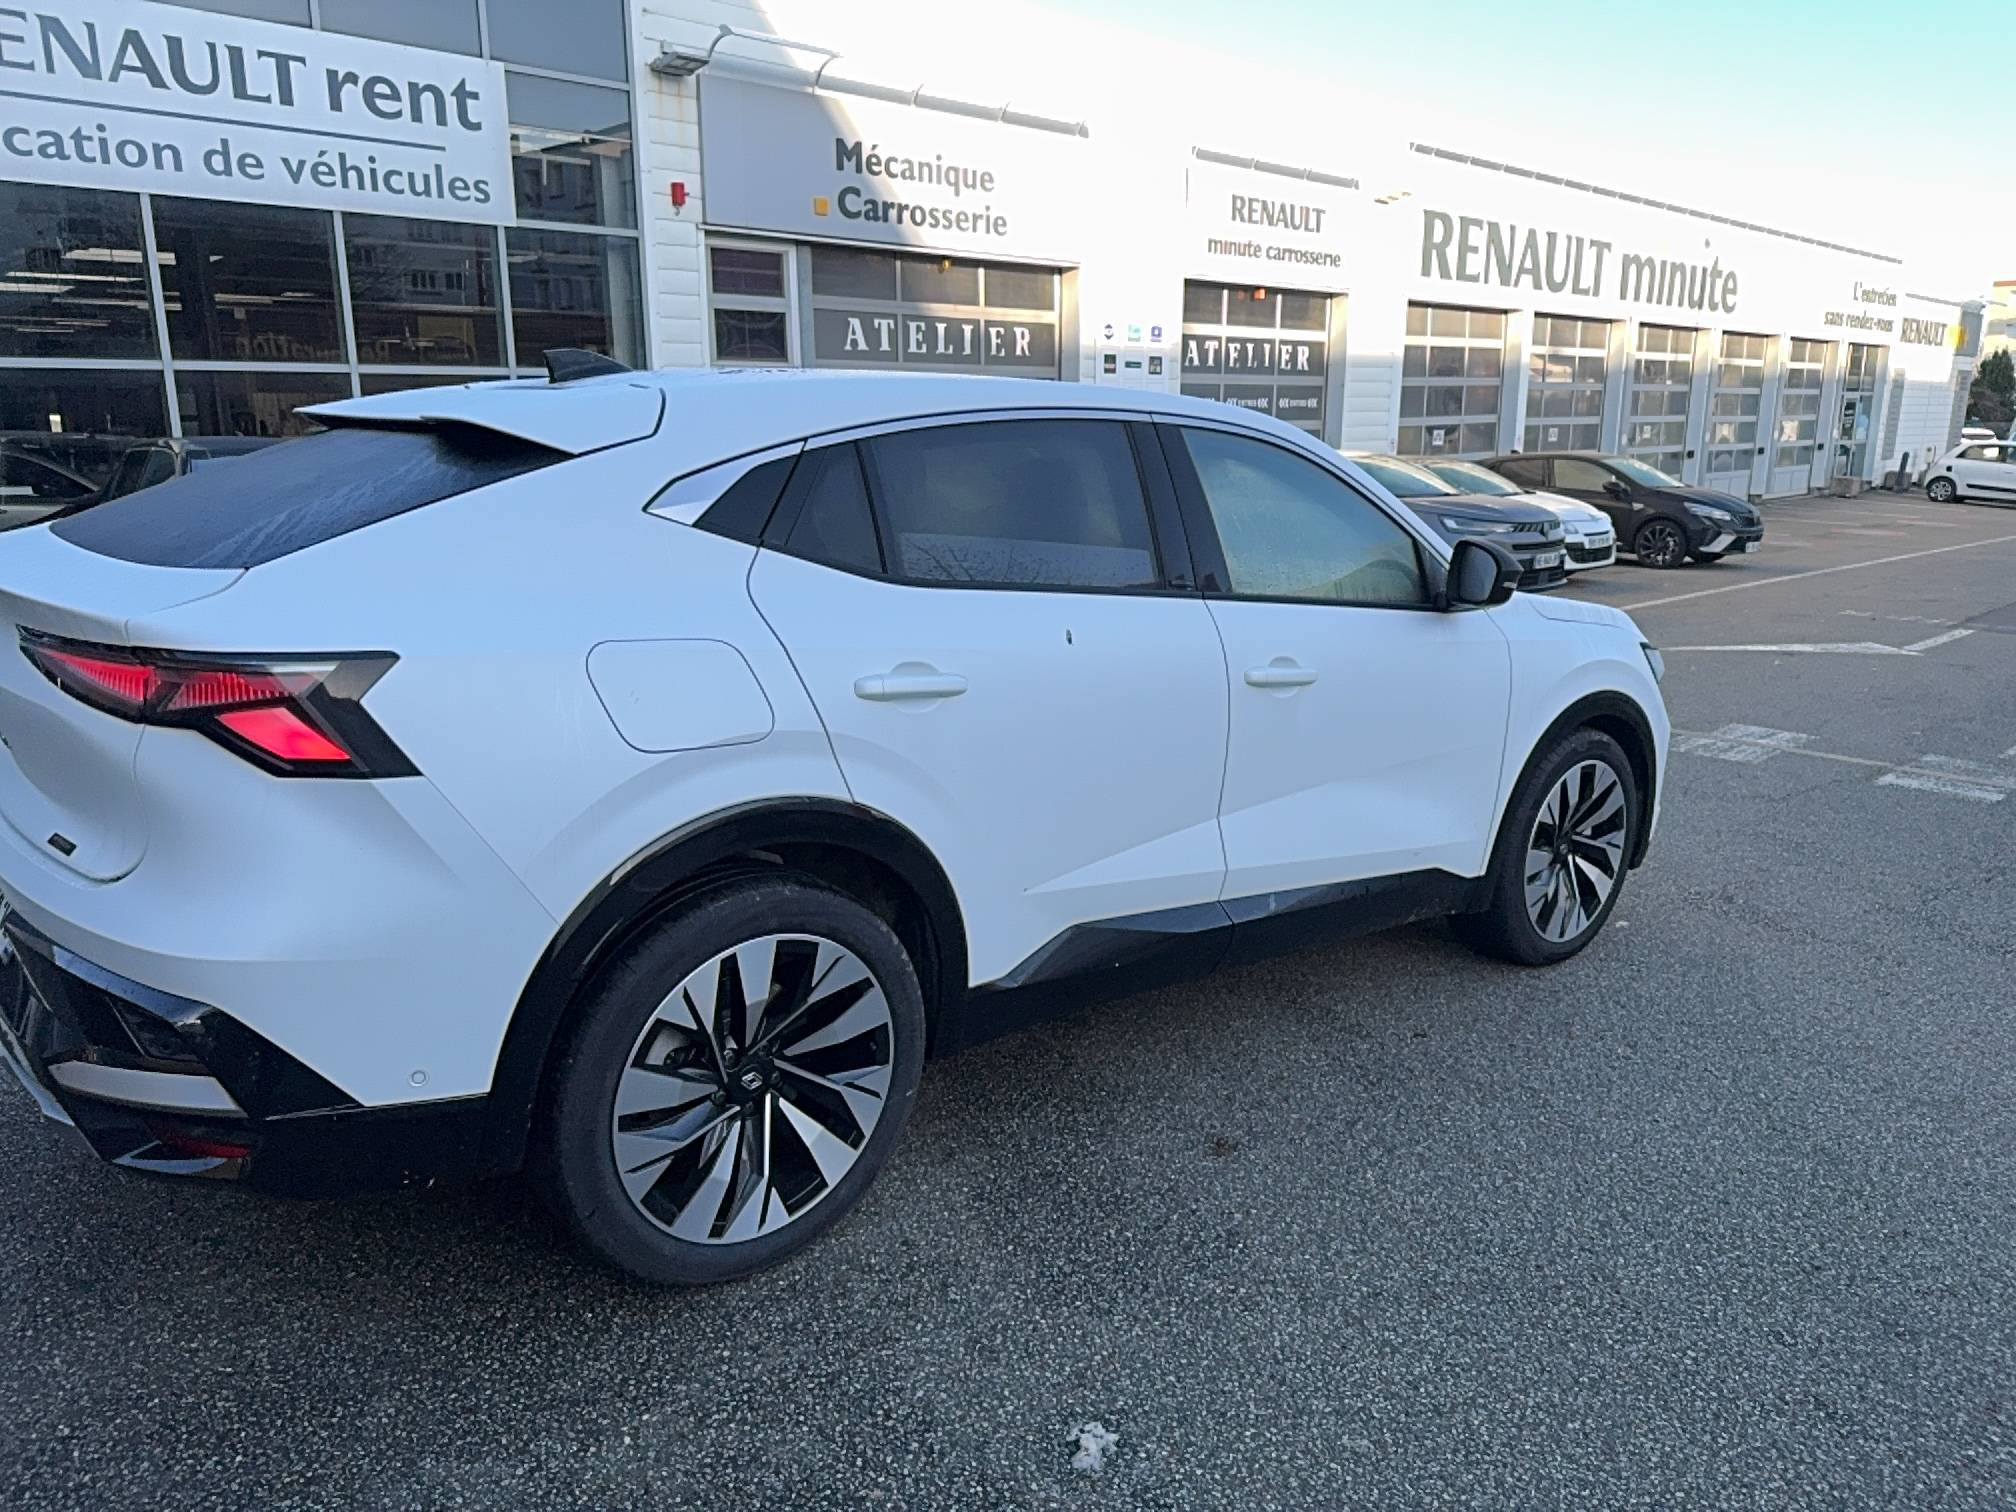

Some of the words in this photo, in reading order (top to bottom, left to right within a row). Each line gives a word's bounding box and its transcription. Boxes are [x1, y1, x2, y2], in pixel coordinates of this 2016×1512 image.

[326, 68, 482, 131] rent
[2, 123, 184, 172] cation
[203, 138, 264, 180] de
[280, 150, 491, 204] véhicules
[835, 138, 994, 197] Mécanique
[838, 186, 1007, 236] Carrosserie
[1231, 194, 1326, 233] RENAULT
[1208, 238, 1262, 259] minute
[1266, 245, 1341, 268] carrosserie
[1421, 209, 1611, 297] RENAULT
[1620, 238, 1737, 314] minute
[844, 318, 1031, 357] ATELIER
[1824, 310, 1844, 327] sans
[1846, 310, 1894, 333] rendez-vous
[1900, 317, 1947, 347] RENAULT
[1184, 339, 1310, 371] ATELIER
